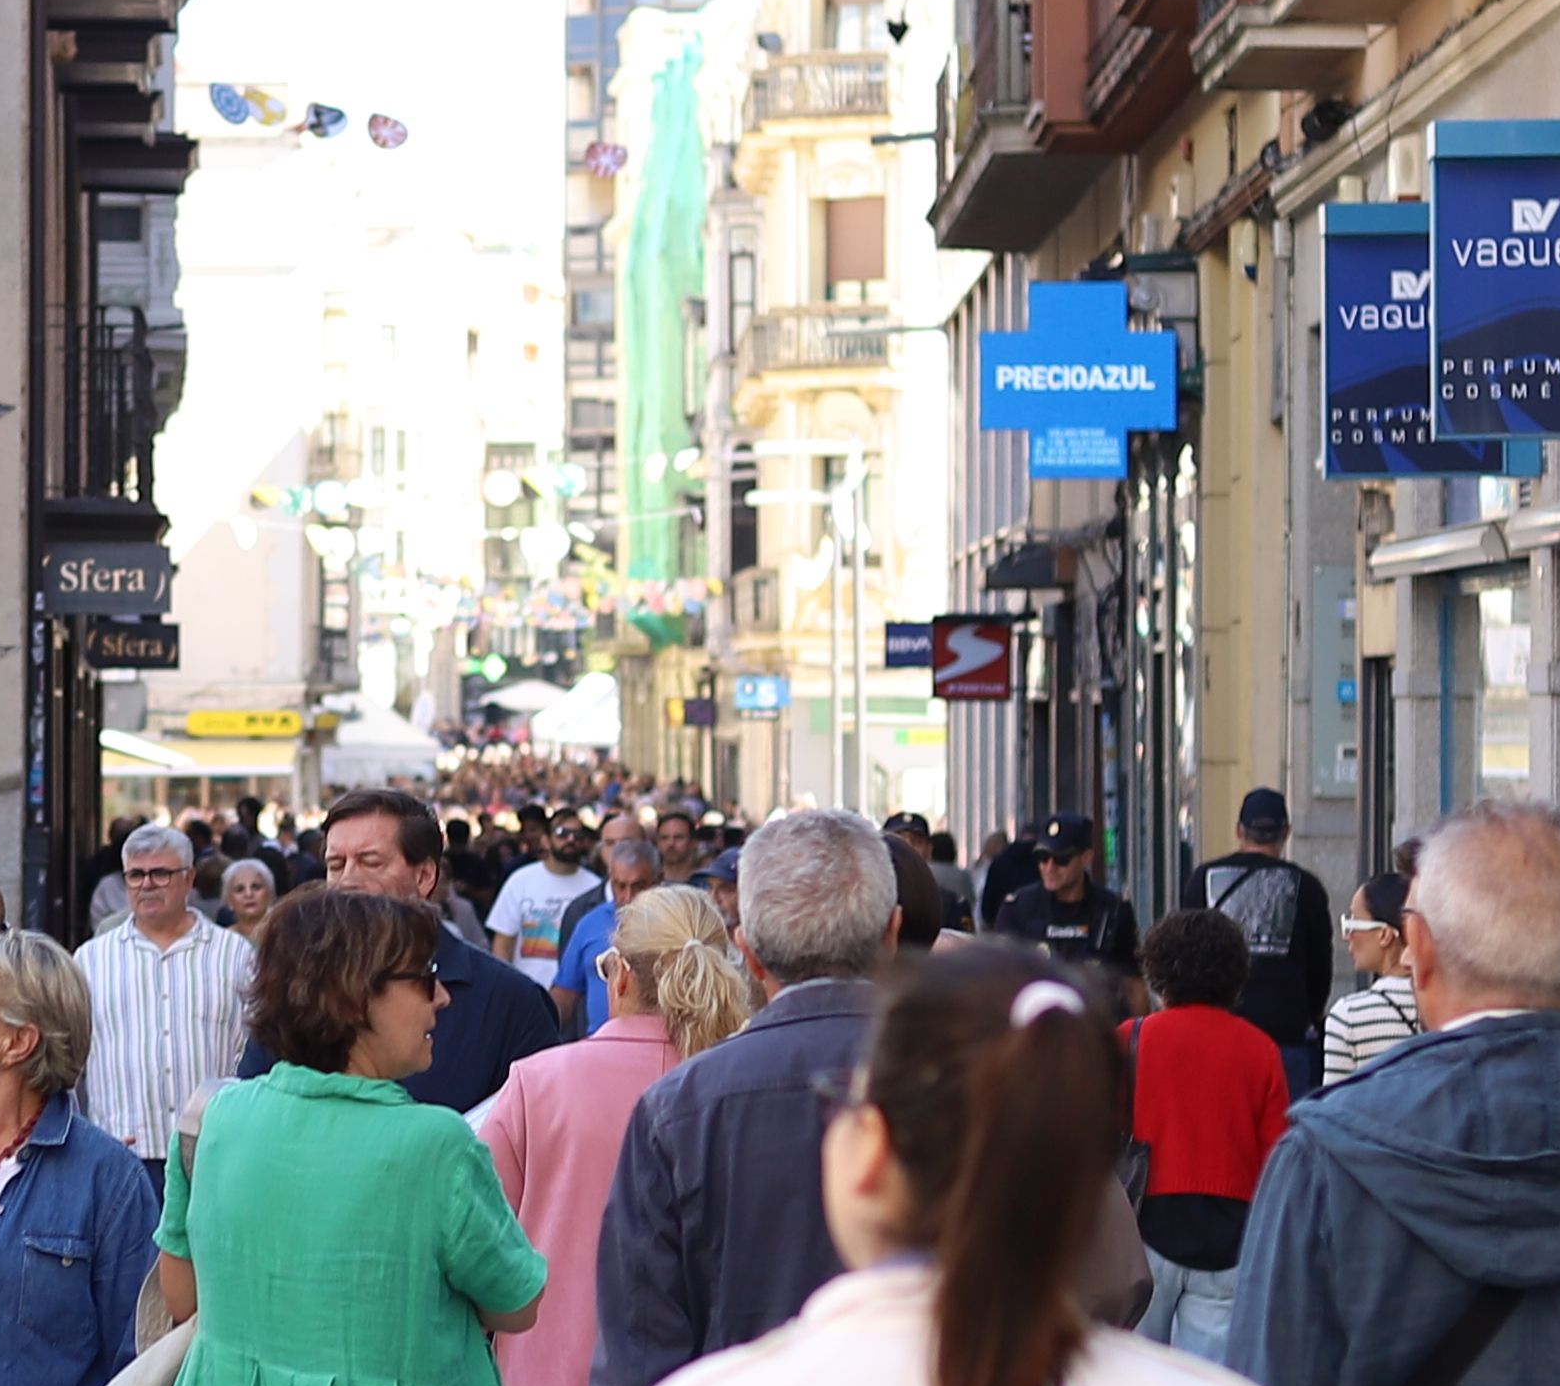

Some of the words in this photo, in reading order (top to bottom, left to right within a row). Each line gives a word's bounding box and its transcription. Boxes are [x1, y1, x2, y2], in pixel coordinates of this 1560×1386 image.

[1339, 304, 1431, 331] vaqu
[995, 365, 1156, 392] PRECIOAZUL
[1332, 427, 1433, 444] COSMÉ
[59, 557, 146, 592] Sfera
[101, 632, 164, 657] Sfera
